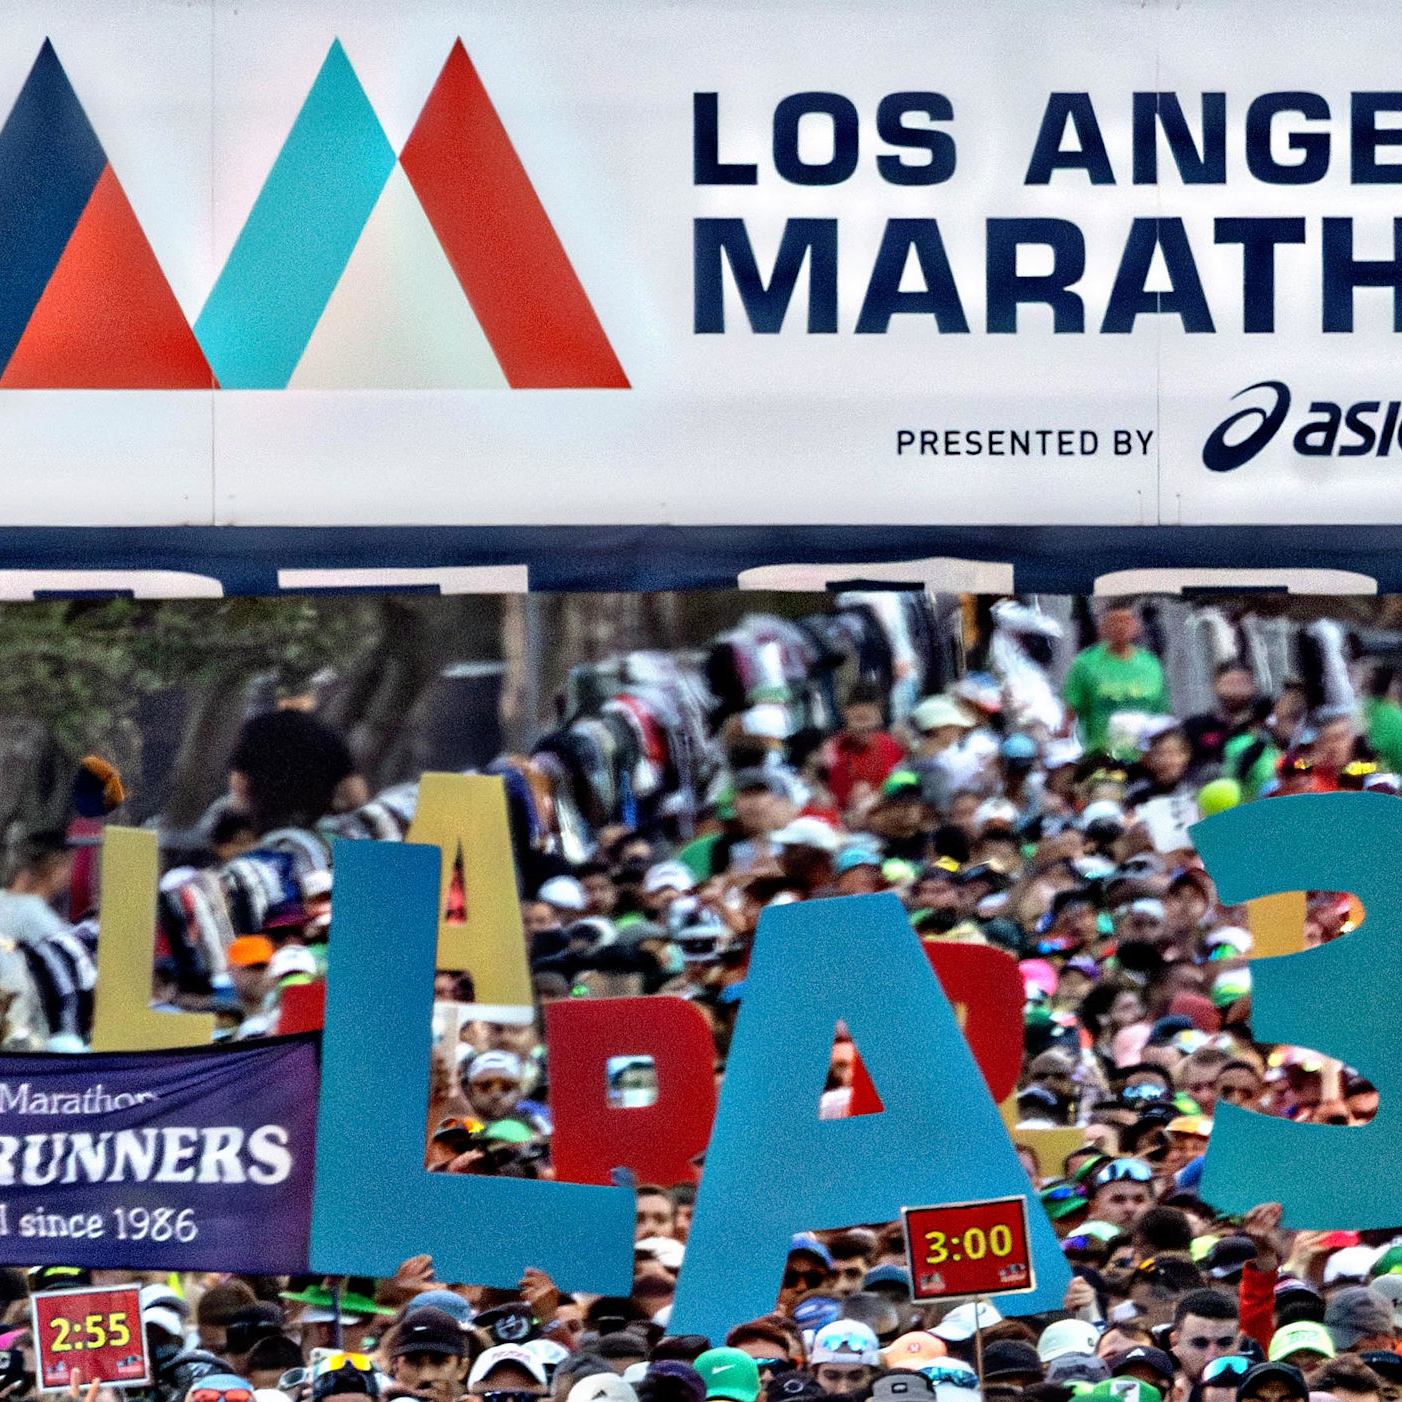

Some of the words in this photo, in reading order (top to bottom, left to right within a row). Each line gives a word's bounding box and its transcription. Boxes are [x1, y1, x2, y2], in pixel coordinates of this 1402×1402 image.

[693, 91, 957, 186] LOS
[896, 430, 1099, 456] PRESENTED
[1110, 430, 1154, 456] BY
[18, 1206, 104, 1239] since
[112, 1206, 198, 1242] 1986
[924, 1224, 1013, 1264] 3:00
[49, 1312, 130, 1353] 2:55
